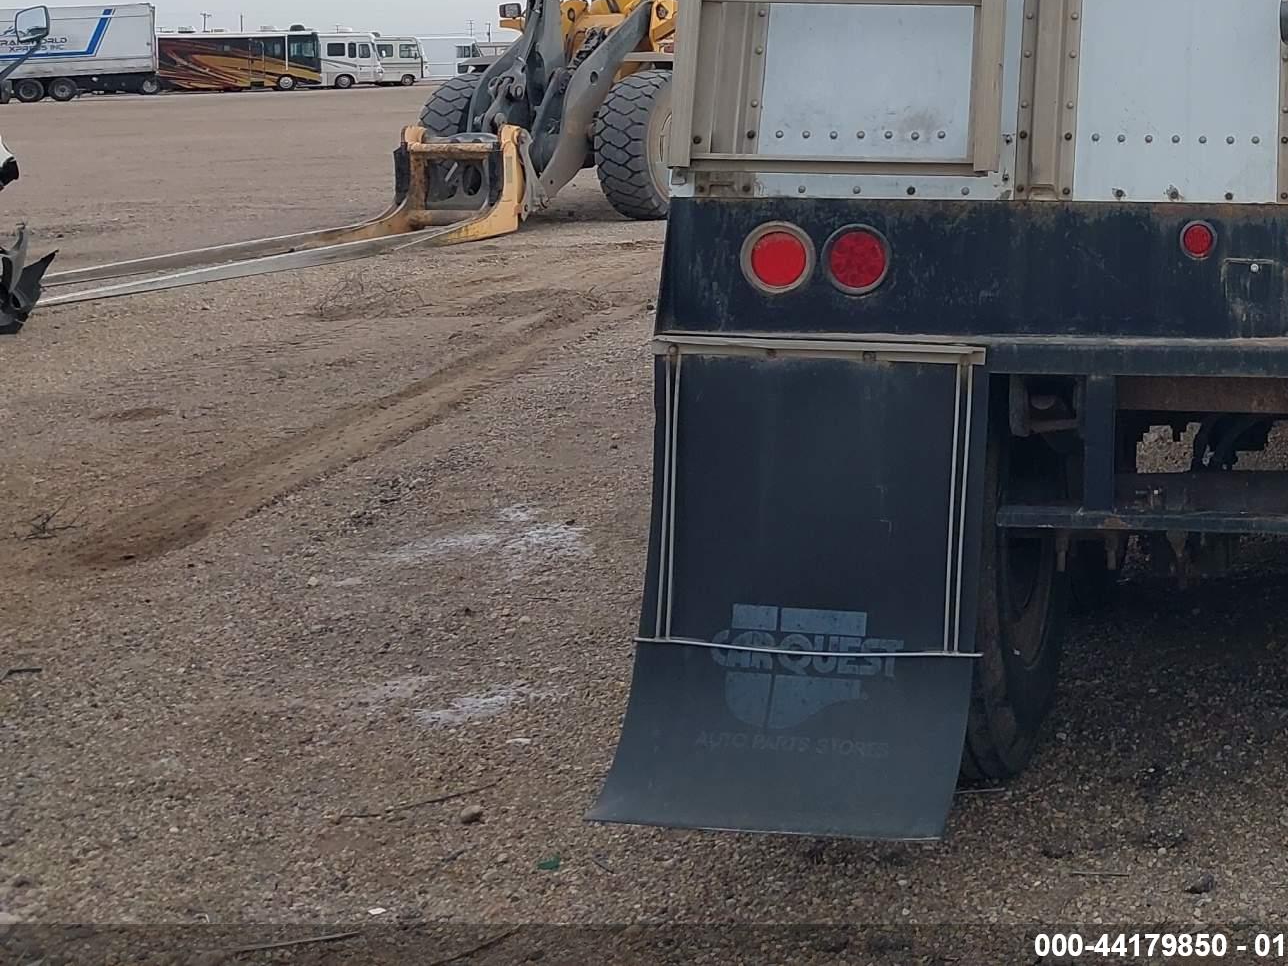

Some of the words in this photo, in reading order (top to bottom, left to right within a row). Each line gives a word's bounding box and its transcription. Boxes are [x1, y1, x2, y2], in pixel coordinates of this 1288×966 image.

[710, 629, 905, 678] CARQUEST
[695, 730, 746, 750] AUTO
[752, 733, 809, 753] PARTS
